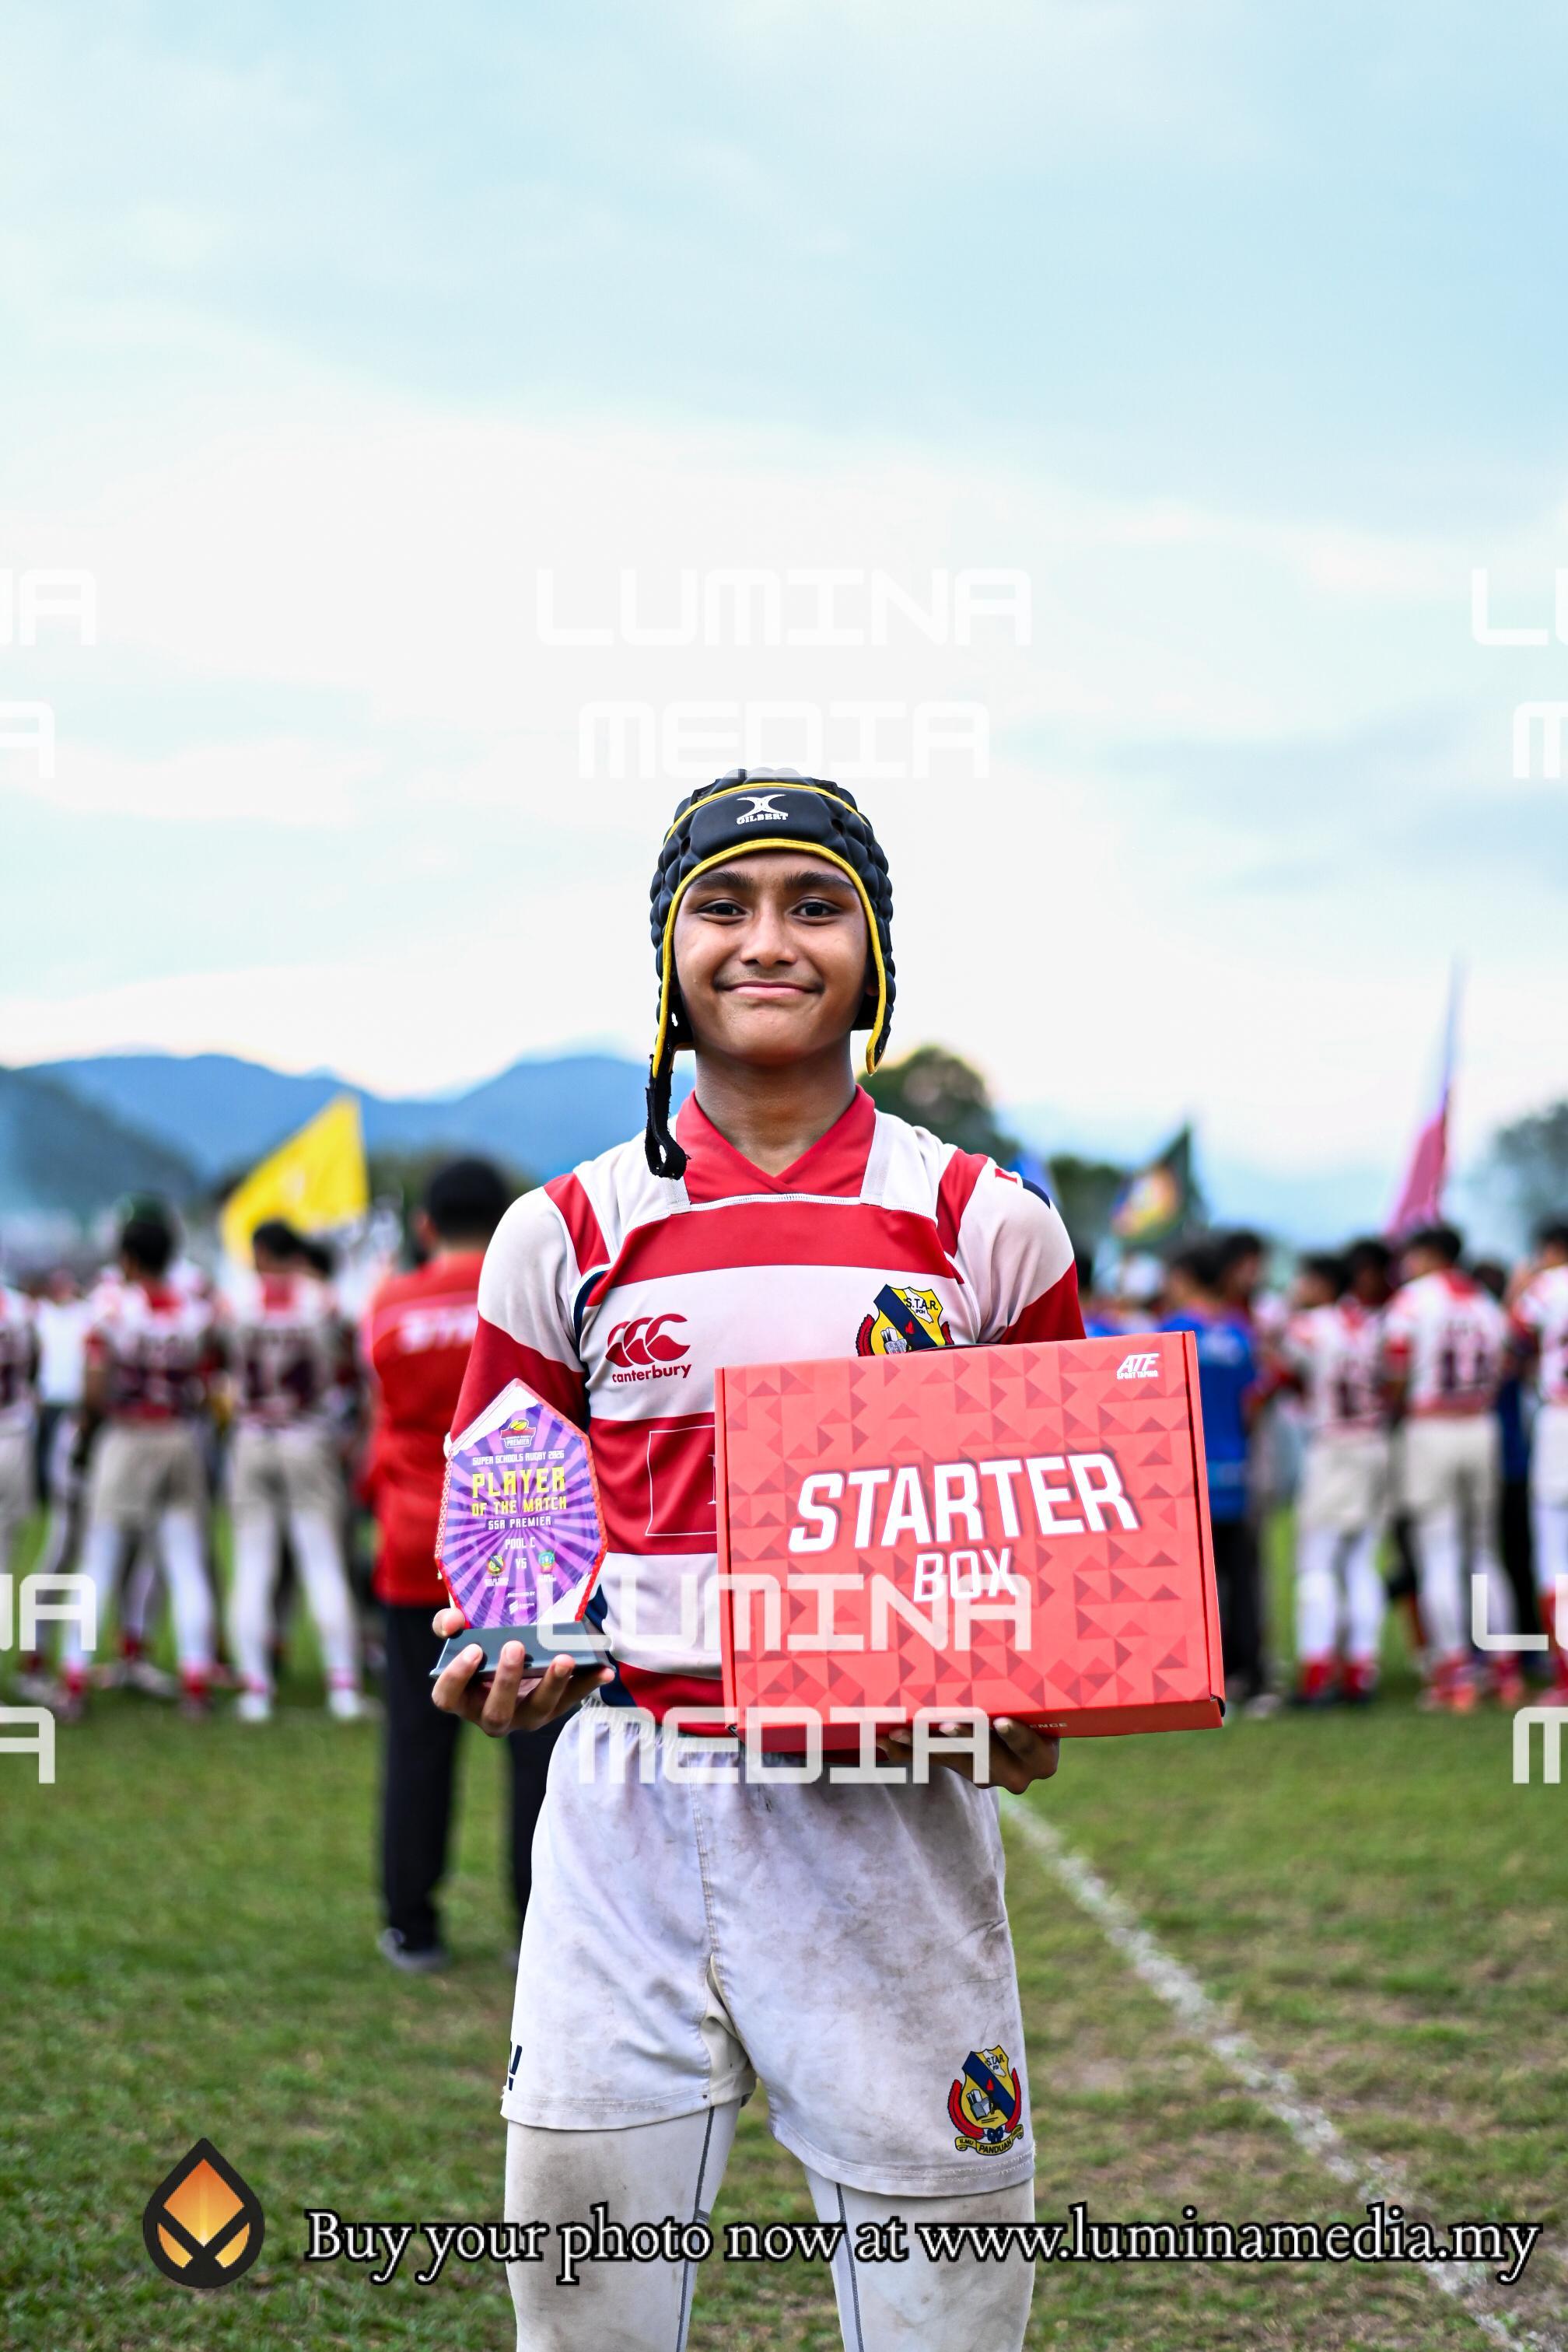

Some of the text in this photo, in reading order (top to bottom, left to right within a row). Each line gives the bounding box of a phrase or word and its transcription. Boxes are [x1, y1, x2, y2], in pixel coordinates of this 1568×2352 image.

[737, 814, 789, 824] GILBERT
[612, 1364, 692, 1383] canterbury
[472, 1456, 494, 1466] SUPER
[495, 1453, 523, 1464] SCHOOLS
[525, 1451, 547, 1462] RUGBY
[472, 1466, 566, 1498] PLAYER
[471, 1496, 567, 1517] OF THE MATCH
[788, 1453, 1139, 1553] STARTER
[509, 1516, 551, 1528] PREMIER
[505, 1536, 536, 1550] POOL C
[515, 1557, 527, 1570] VS
[912, 1547, 1019, 1603] BOX
[979, 2139, 1012, 2154] PANDUAN
